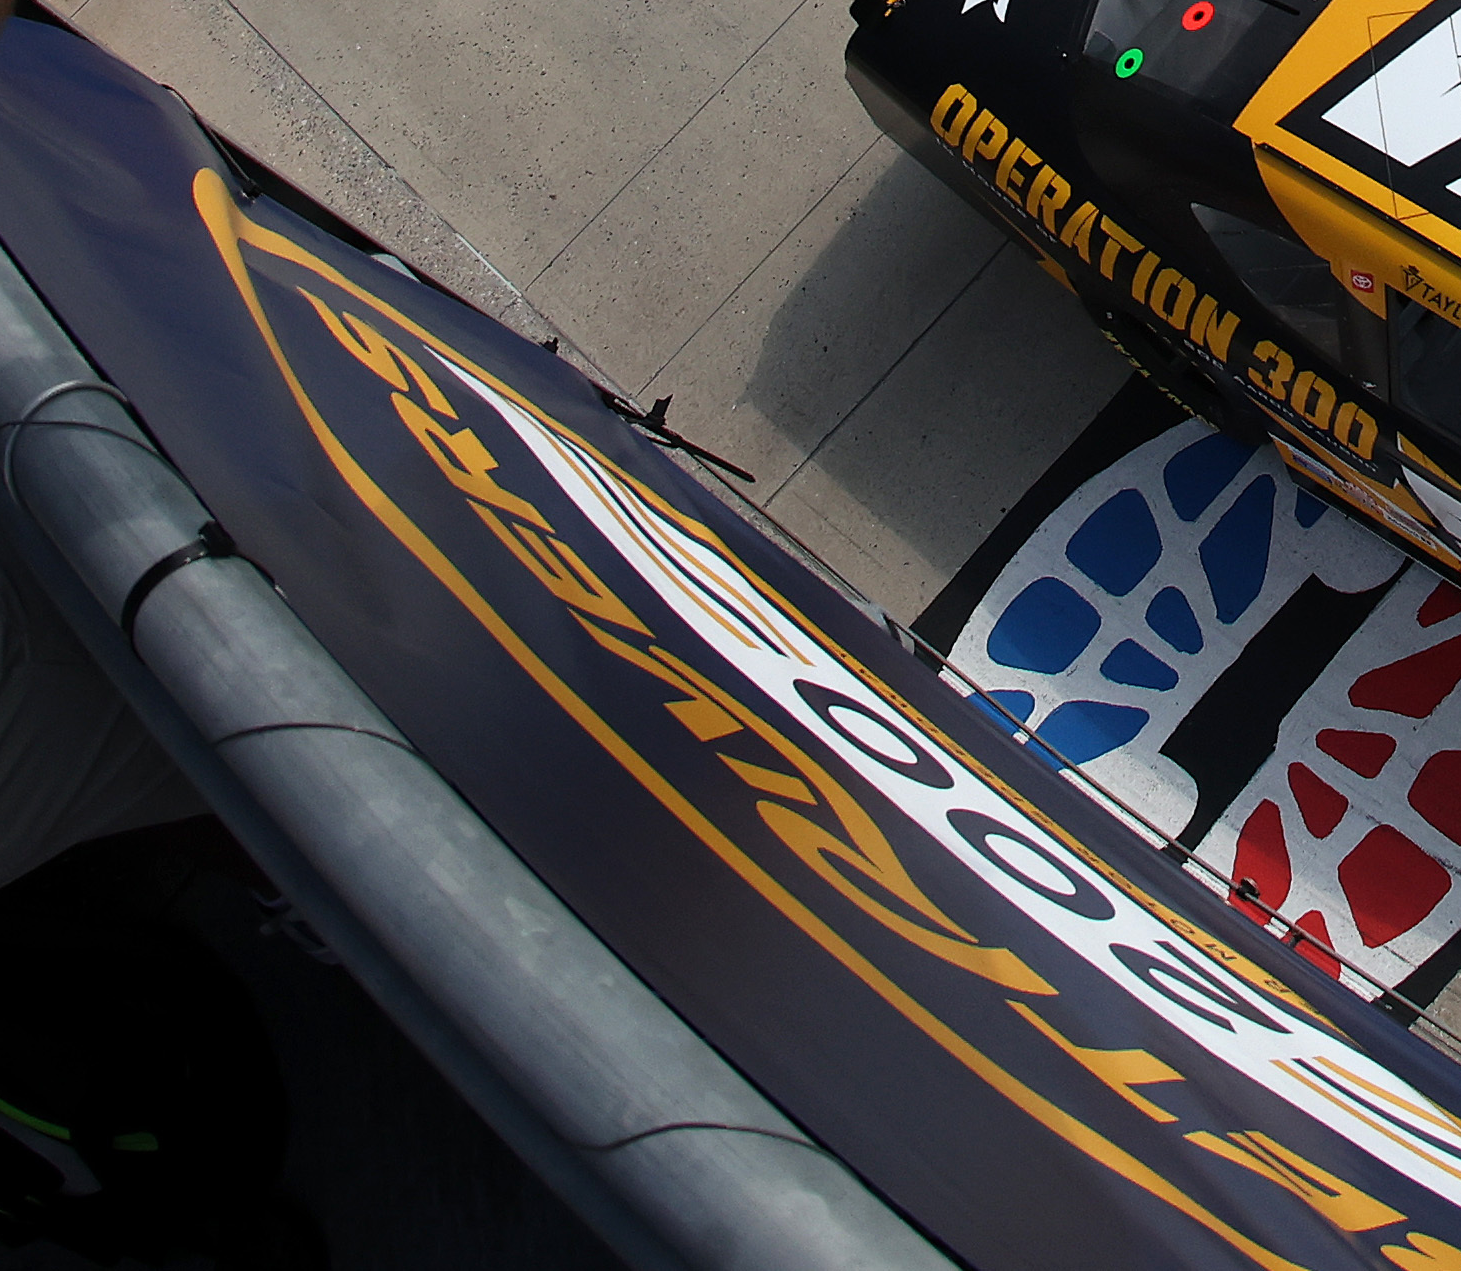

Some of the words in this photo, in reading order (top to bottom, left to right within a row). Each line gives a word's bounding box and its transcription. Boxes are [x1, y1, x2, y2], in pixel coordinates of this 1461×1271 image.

[929, 82, 1241, 362] OPERATION
[1246, 338, 1381, 463] 300
[791, 675, 1291, 1036] 200
